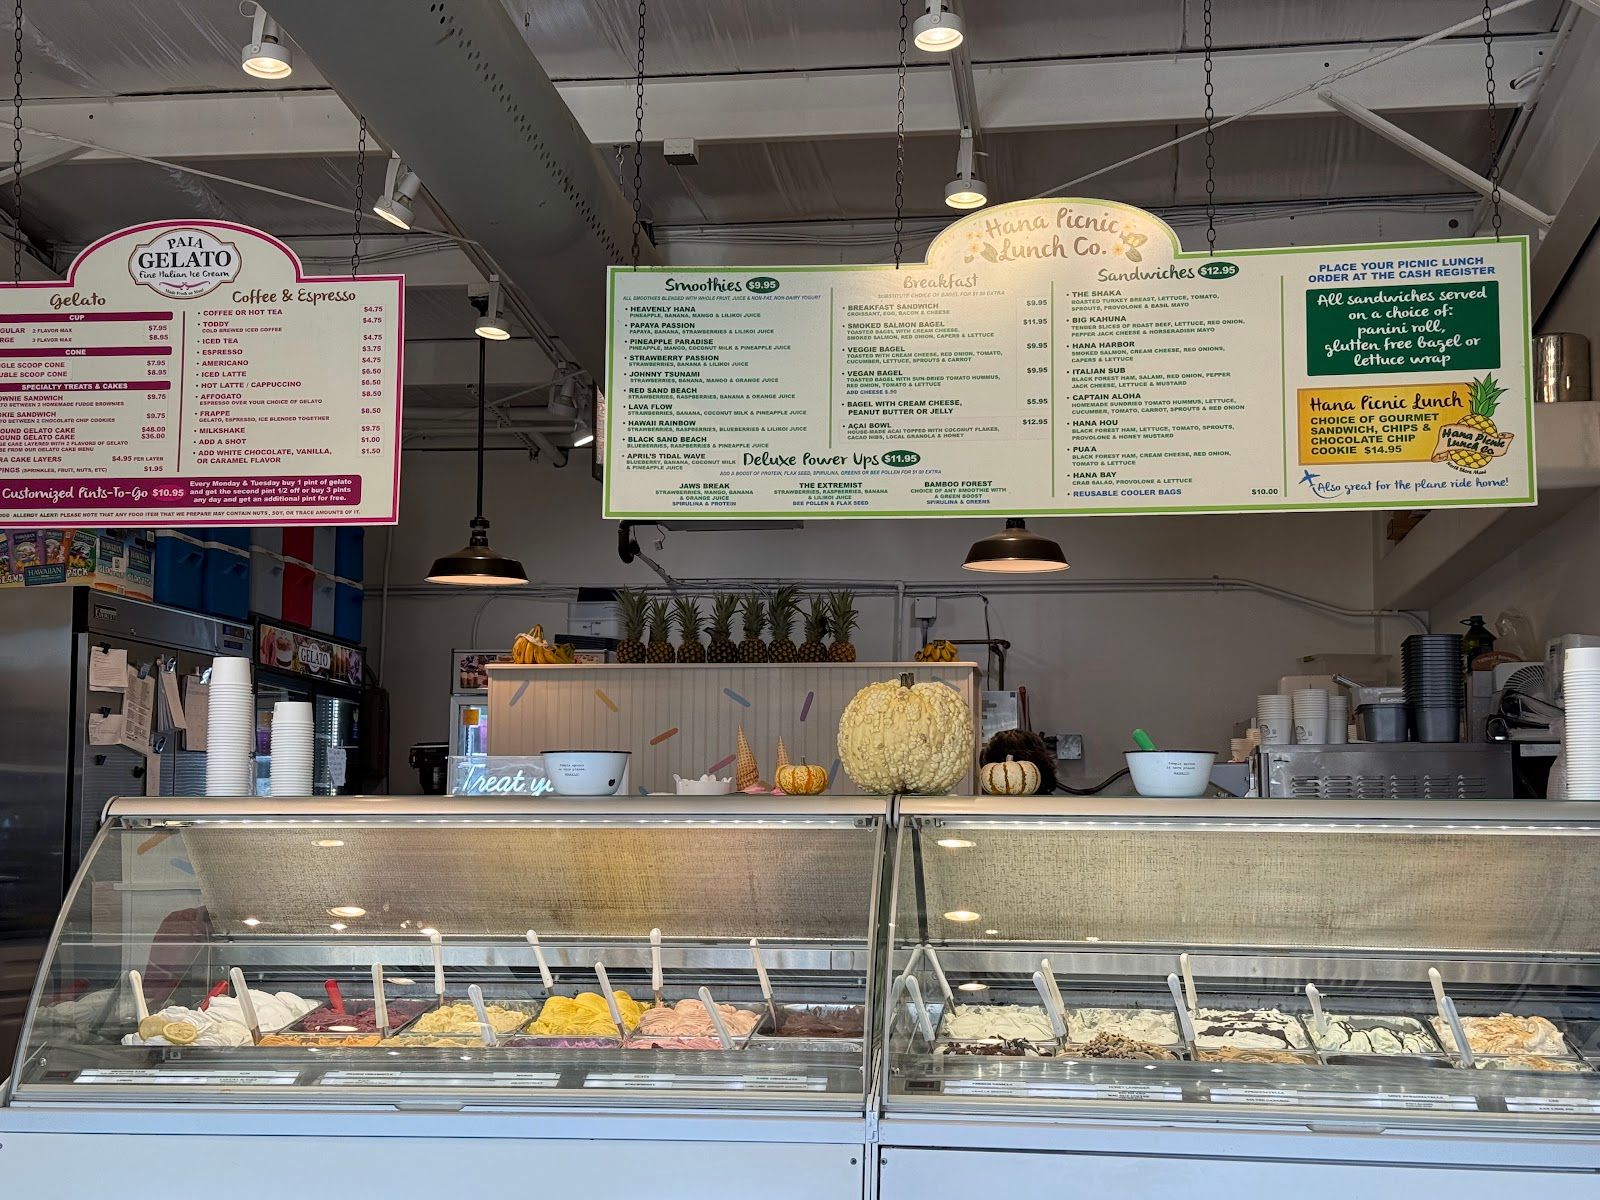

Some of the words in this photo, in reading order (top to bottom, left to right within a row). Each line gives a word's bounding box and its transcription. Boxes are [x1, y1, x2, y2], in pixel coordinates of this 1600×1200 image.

[985, 216, 1050, 238] Hana
[1057, 208, 1120, 234] Picnic
[167, 237, 204, 249] PAIA
[998, 234, 1066, 261] Lunch
[1074, 237, 1106, 255] Co.
[138, 251, 231, 268] GELATO
[1319, 263, 1357, 272] PLACE
[1361, 262, 1393, 270] YOUR
[1398, 260, 1437, 268] PICNIC
[1442, 257, 1484, 267] LUNCH
[903, 273, 979, 289] Breakfast
[1098, 265, 1196, 282] Sandwiches
[1200, 267, 1236, 275] $12.95
[1308, 274, 1348, 283] ORDER
[1371, 271, 1394, 280] THE
[1399, 269, 1431, 279] CASH
[1436, 267, 1495, 277] REGISTER
[665, 278, 742, 292] Smoothies
[749, 281, 776, 289] $9.95
[50, 292, 106, 310] Gelato
[232, 290, 277, 304] Coffee
[282, 289, 293, 301] &
[299, 289, 355, 306] Espresso
[1317, 293, 1344, 306] All
[1347, 289, 1435, 305] sandwiches
[1439, 286, 1487, 300] served
[1349, 311, 1366, 320] on
[1371, 310, 1382, 318] a
[1386, 307, 1429, 318] choice
[1434, 304, 1453, 317] of:
[1358, 322, 1408, 338] panini
[1412, 320, 1446, 334] roll,
[1324, 339, 1381, 357] glutten
[1384, 338, 1412, 350] free
[1418, 335, 1460, 351] bagel
[1465, 337, 1480, 346] or
[1354, 353, 1404, 366] lettuce
[1410, 356, 1450, 368] wrap
[1310, 397, 1355, 411] Hana
[1361, 395, 1408, 410] Picnic
[1412, 391, 1464, 408] Lunch
[1379, 414, 1439, 422] GOURMET
[1311, 426, 1378, 435] SANDWICH,
[1382, 424, 1418, 432] CHIPS
[1423, 424, 1431, 432] &
[1311, 436, 1383, 445] CHOCOLATE
[1312, 447, 1356, 455] COOKIE
[1364, 446, 1402, 454] $14.95
[743, 451, 797, 467] Deluxe
[803, 451, 848, 467] Power
[853, 452, 880, 469] Ups
[884, 454, 918, 464] $11.95
[1317, 481, 1341, 492] Also
[1345, 480, 1371, 494] great
[1376, 479, 1391, 490] for
[1394, 478, 1411, 489] the
[1415, 478, 1446, 494] plane
[1450, 478, 1471, 487] ride
[1476, 477, 1508, 487] home!
[2, 487, 74, 503] Customized
[79, 486, 148, 500] Pints-To-Go
[66, 568, 88, 577] PACK
[301, 648, 328, 666] GELATO
[457, 763, 525, 794] Treat
